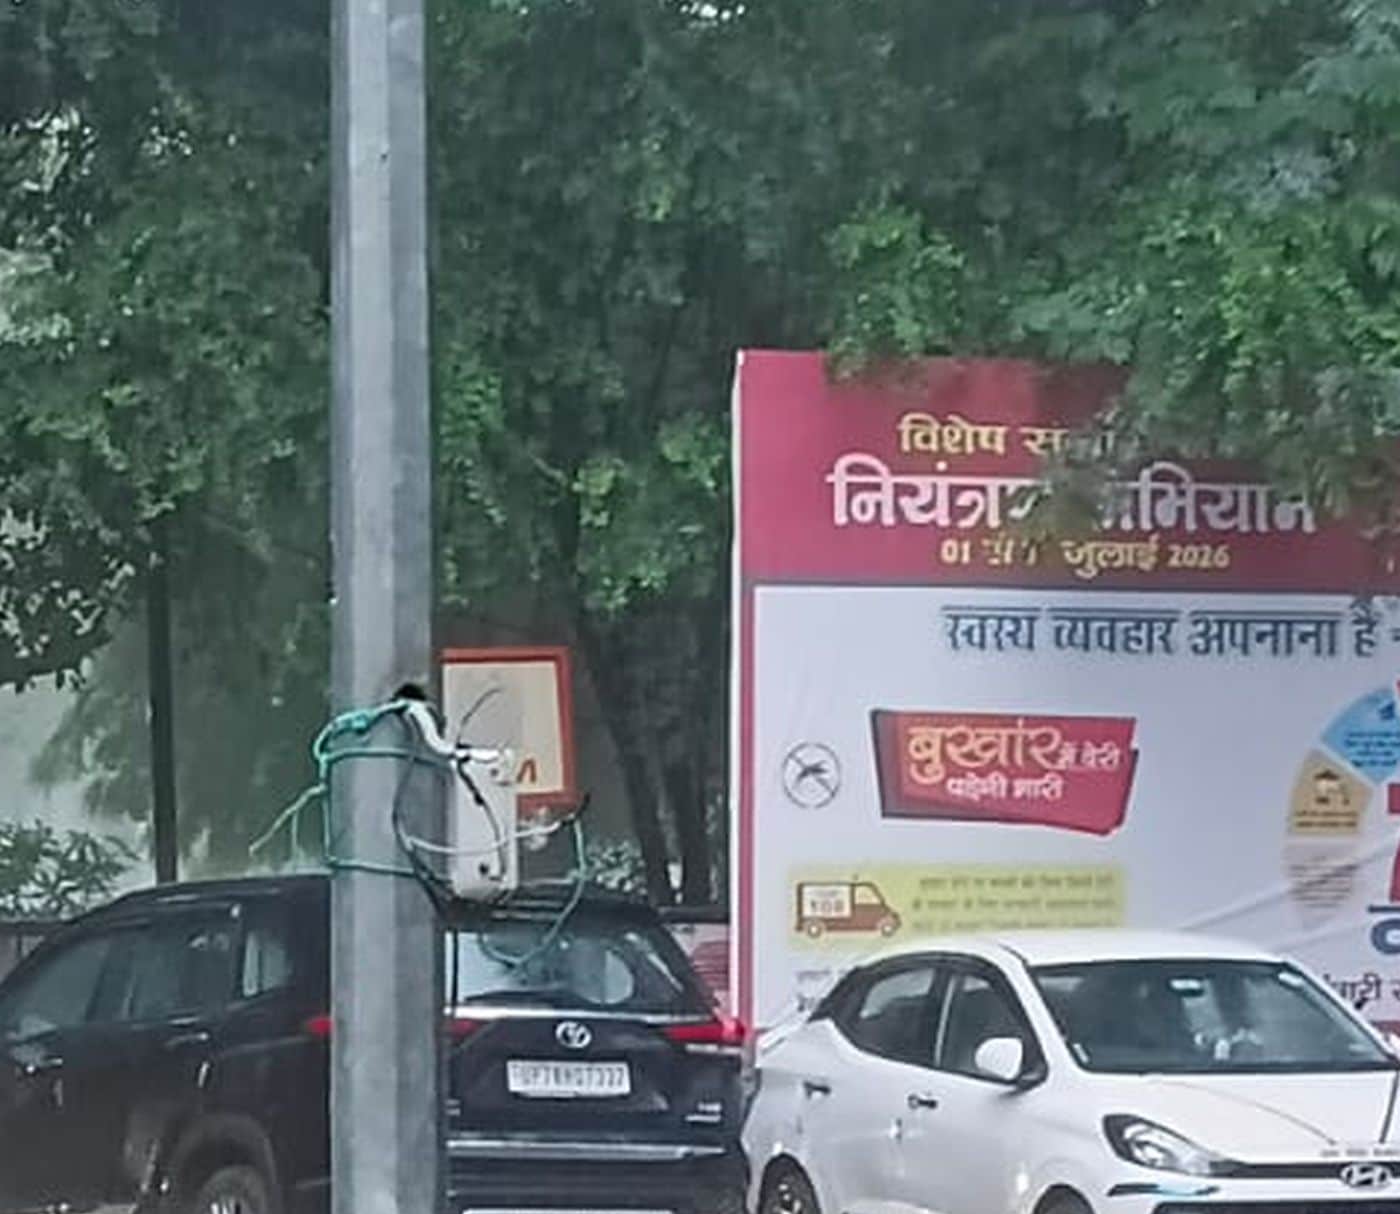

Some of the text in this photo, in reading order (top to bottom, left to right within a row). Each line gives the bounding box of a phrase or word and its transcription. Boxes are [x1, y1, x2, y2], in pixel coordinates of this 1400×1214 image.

[898, 412, 1008, 455] विशेष
[940, 538, 971, 564] 01
[1060, 534, 1160, 578] जुलाई
[1167, 544, 1231, 568] 2026
[1047, 607, 1182, 655] व्यवहार
[1188, 609, 1345, 657] अपनाना
